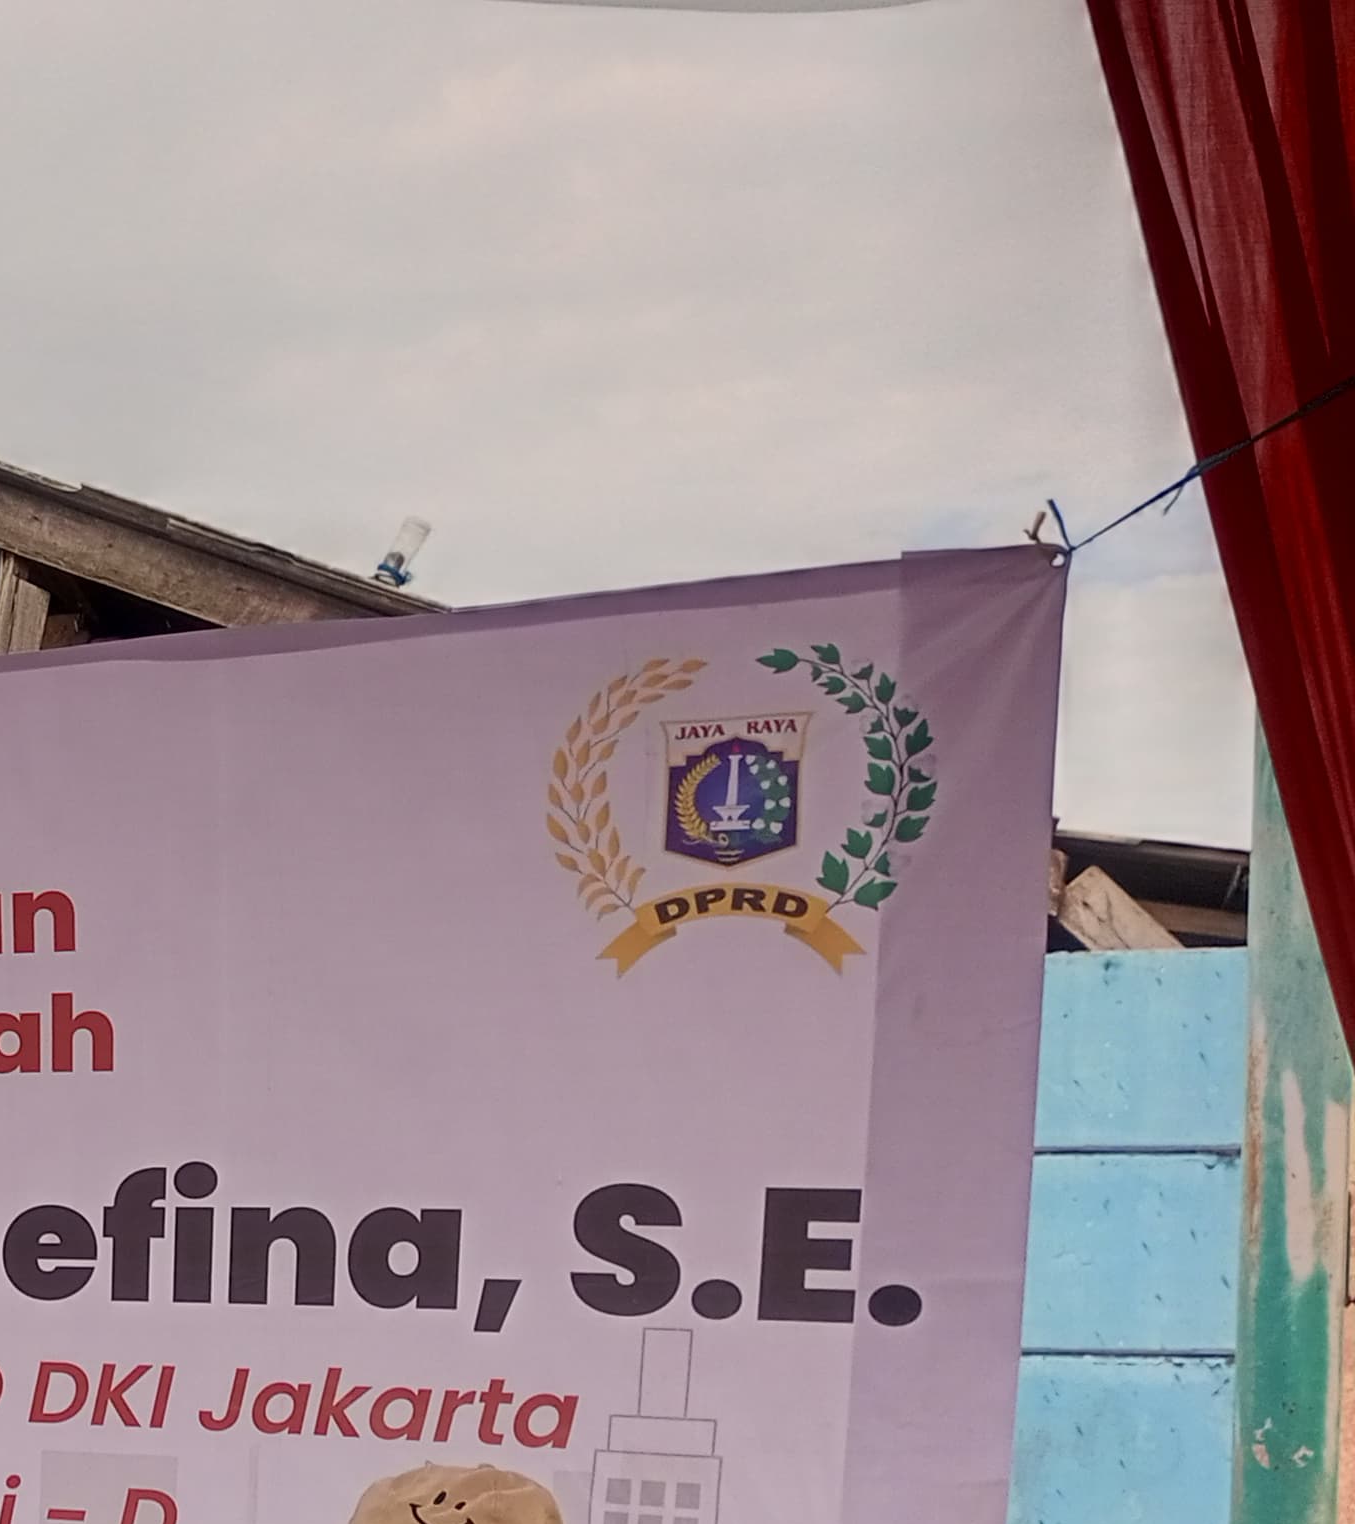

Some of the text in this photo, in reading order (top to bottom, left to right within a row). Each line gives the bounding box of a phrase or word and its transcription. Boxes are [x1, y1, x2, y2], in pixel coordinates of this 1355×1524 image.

[674, 718, 799, 742] JAYA RAYA
[654, 887, 810, 925] DPRD
[570, 1183, 924, 1328] S.E.
[28, 1359, 176, 1429] DKI
[198, 1365, 581, 1449] Jakarta
